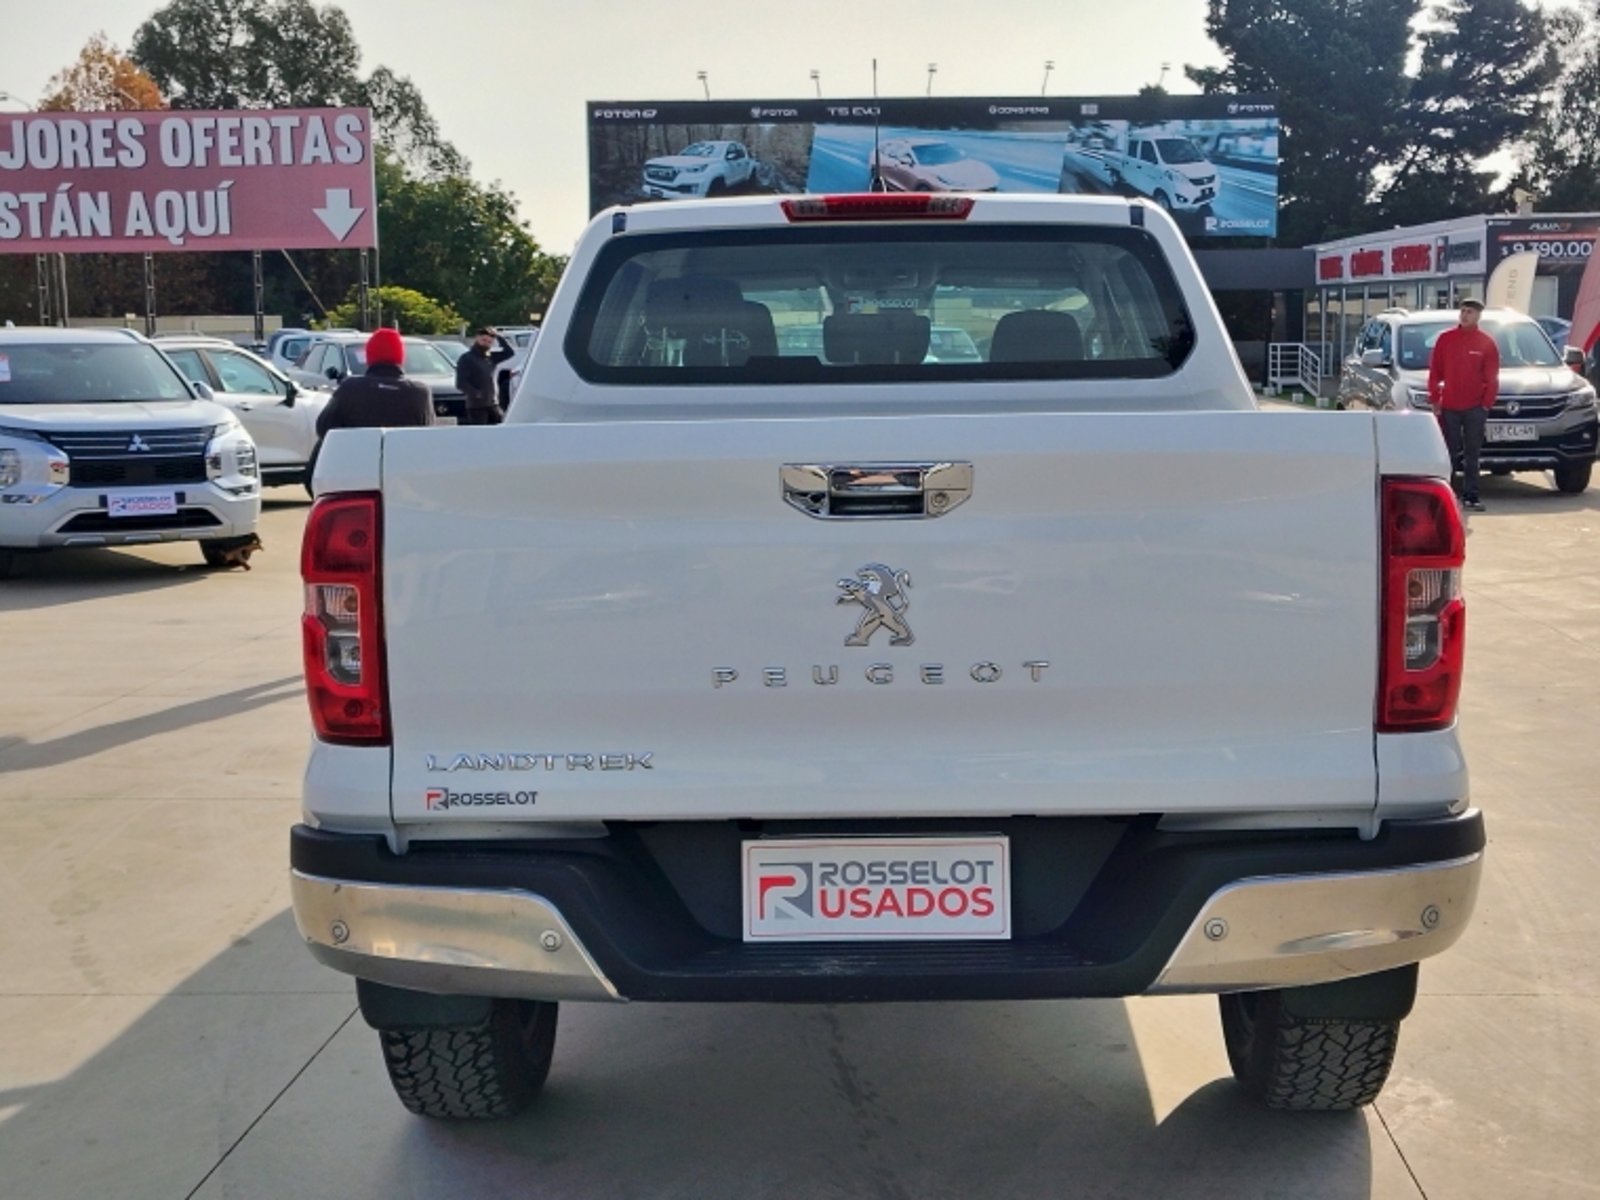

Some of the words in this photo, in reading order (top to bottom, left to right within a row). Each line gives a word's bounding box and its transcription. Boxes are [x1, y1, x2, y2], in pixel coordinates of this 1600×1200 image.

[0, 117, 146, 169] JORES
[159, 113, 365, 168] OFERTAS
[0, 182, 113, 239] STÁN
[125, 180, 235, 245] AQUÍ
[711, 660, 1050, 689] PEUGEOT
[425, 752, 654, 771] LANDTREK
[449, 790, 539, 807] ROSSELOT
[818, 859, 995, 887] ROSSELOT
[818, 887, 996, 919] USADOS
